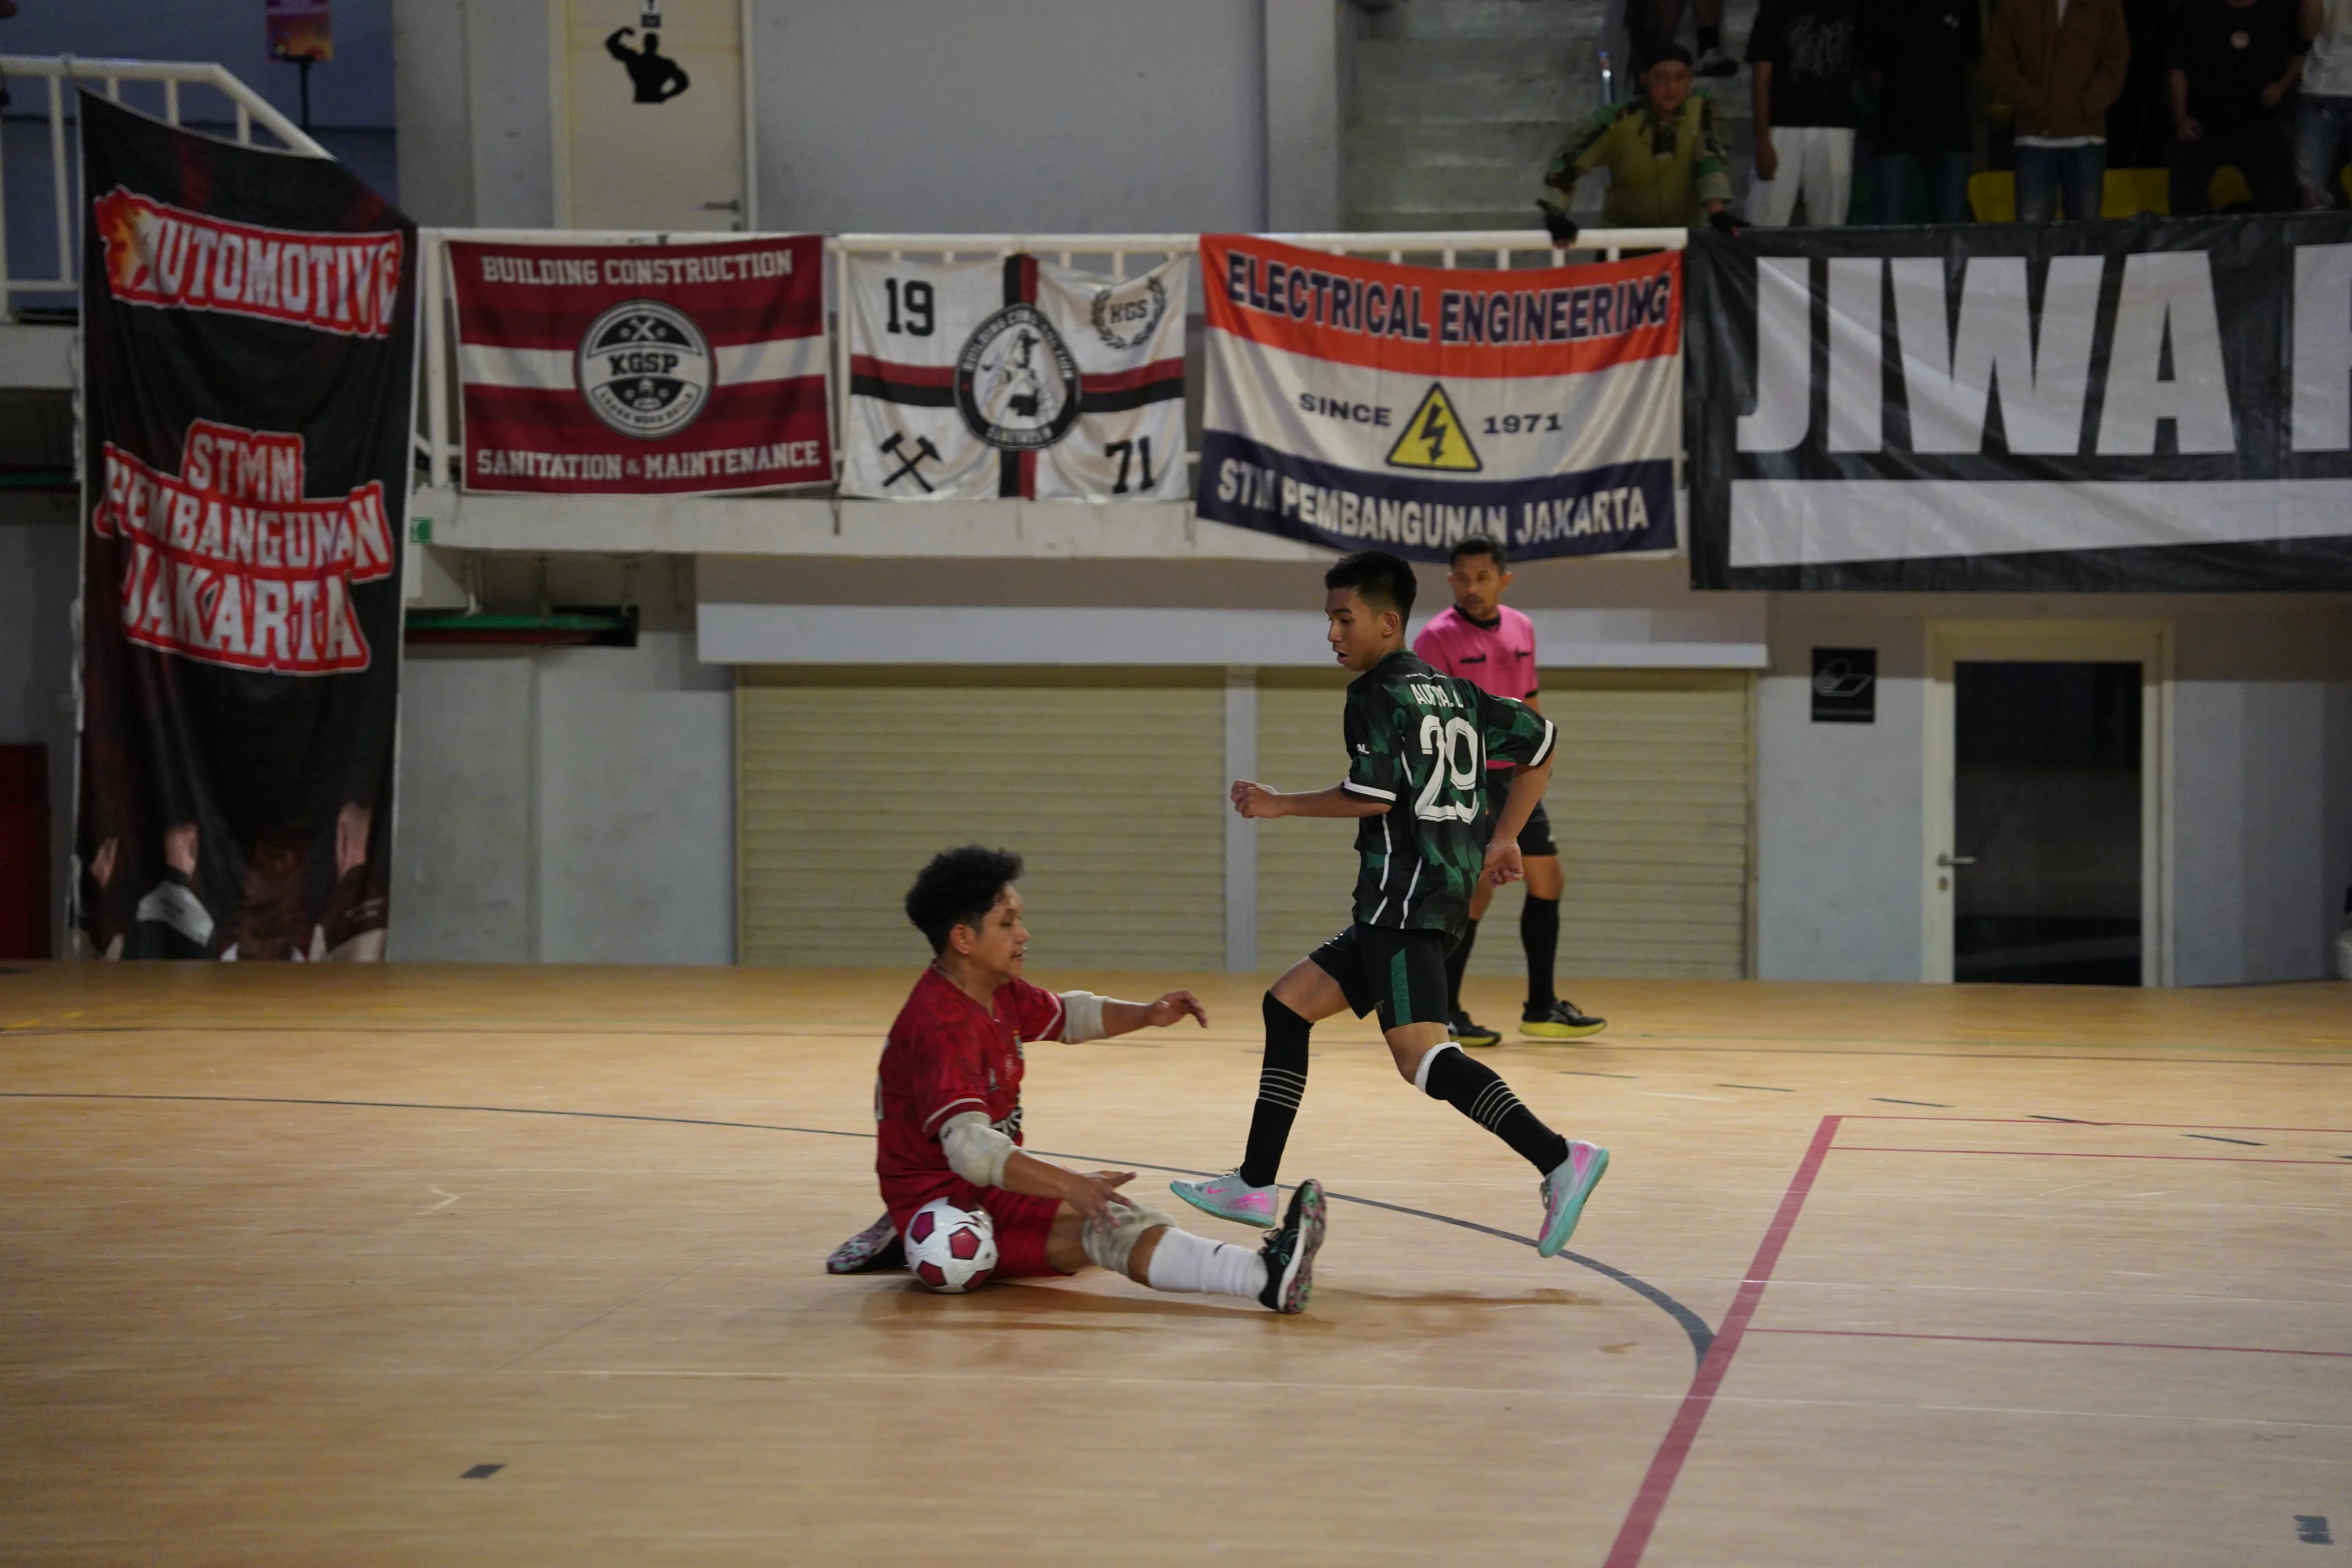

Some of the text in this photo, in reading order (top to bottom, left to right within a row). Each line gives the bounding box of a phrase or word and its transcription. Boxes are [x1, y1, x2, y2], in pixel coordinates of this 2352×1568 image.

[481, 249, 794, 286] BUILDING CONSTRUCTION
[1226, 249, 1672, 345] ELECTRICAL ENGINEERING
[885, 277, 936, 336] 19
[608, 353, 680, 376] KGSP
[1736, 250, 2237, 455] JIWA
[1298, 393, 1563, 435] SINCE 1971
[186, 432, 296, 503] STMN
[477, 439, 821, 480] SANITATION & MAINTENANCE
[1104, 434, 1155, 494] 71
[105, 455, 389, 568] PEMBANGUNAN
[1217, 457, 1649, 549] STM PEMBANGUNAN JAKARTA
[126, 543, 361, 661] JAKARTA
